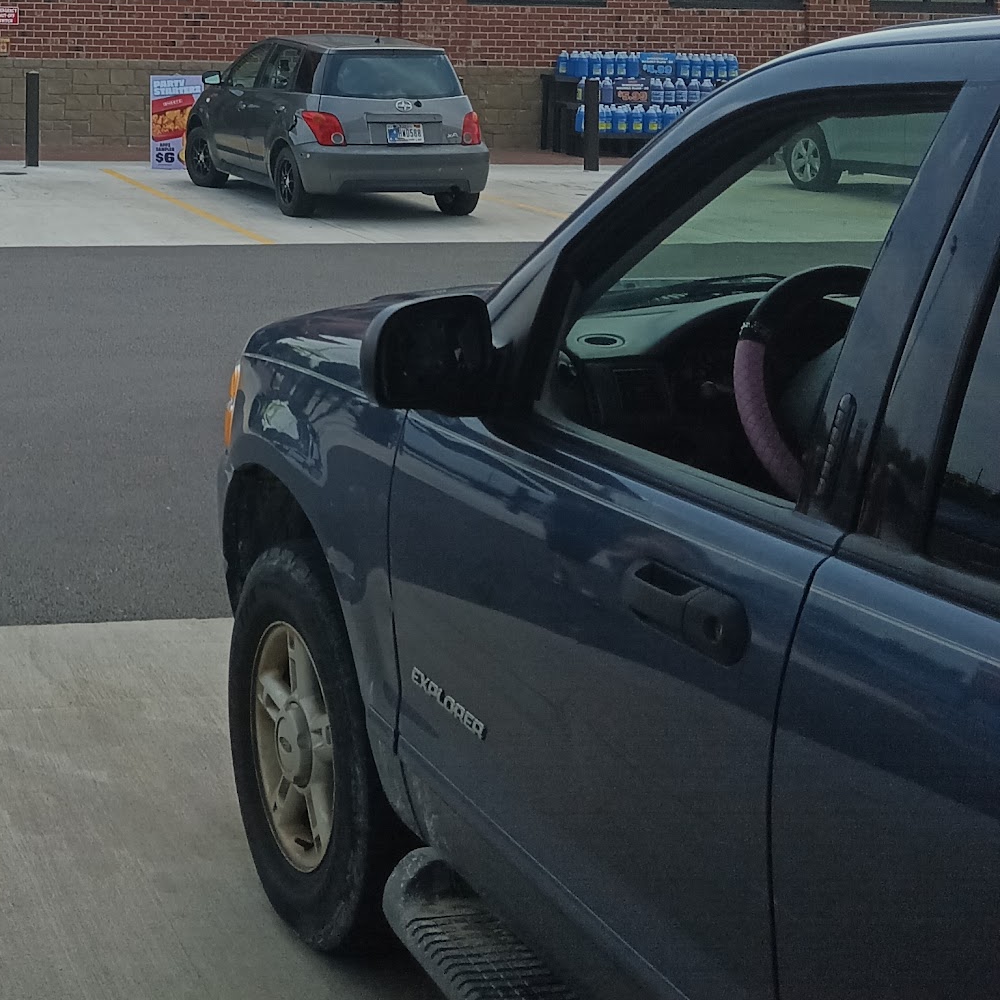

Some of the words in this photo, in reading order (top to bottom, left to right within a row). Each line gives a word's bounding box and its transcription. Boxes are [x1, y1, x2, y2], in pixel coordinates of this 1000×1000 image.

[153, 79, 186, 88] PARTY
[155, 152, 175, 163] $6
[411, 666, 487, 740] EXPLORER
